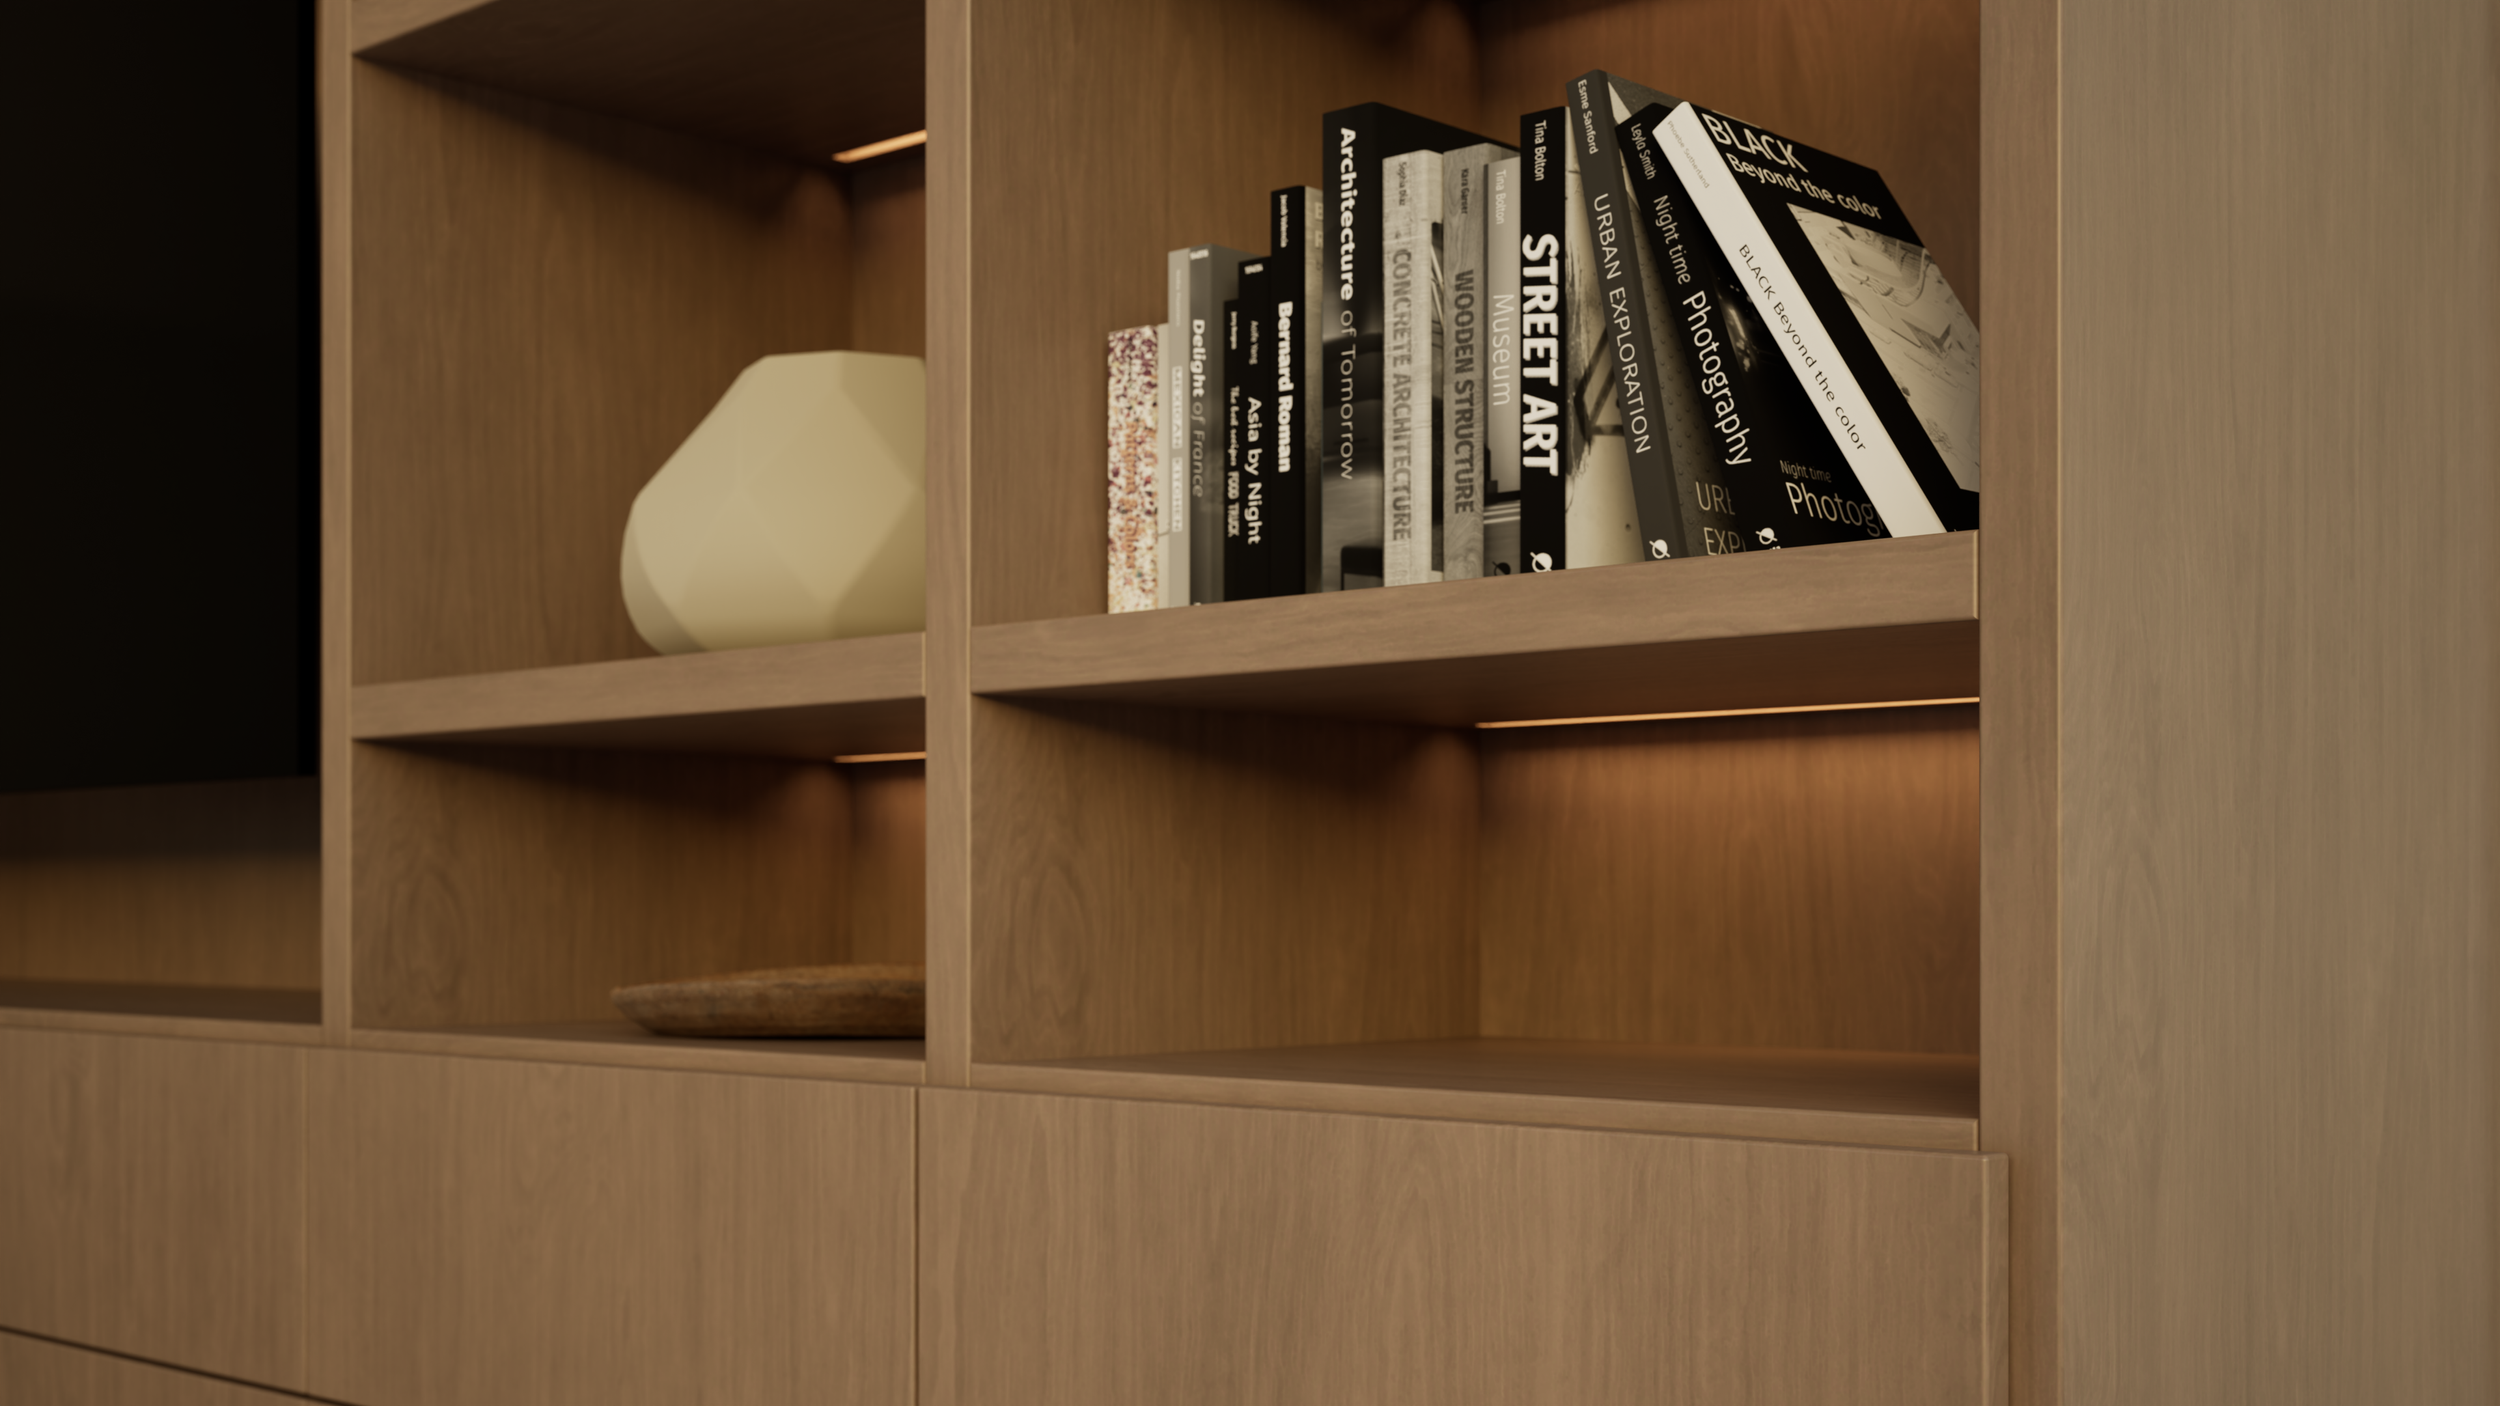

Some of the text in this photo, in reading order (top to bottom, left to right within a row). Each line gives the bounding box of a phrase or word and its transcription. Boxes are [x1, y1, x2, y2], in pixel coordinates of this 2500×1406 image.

[1534, 120, 1547, 182] Tina Bolton
[1578, 79, 1599, 155] Esme Sanford
[1631, 123, 1657, 180] Leyla Smith
[1667, 120, 1710, 189] Phoebe Sutherland
[1701, 113, 1809, 173] BLACK
[1496, 169, 1507, 225] Tina Bolton
[1725, 152, 1882, 220] Beyond the color
[1340, 127, 1358, 480] Architecture of Tomorrow
[1594, 193, 1651, 454] URBAN EXPLORATION
[1653, 195, 1752, 465] Night time Photography
[1493, 293, 1515, 406] Museum
[1522, 234, 1559, 477] STREET ART
[1738, 244, 1866, 450] BLACK Beyond the color
[1190, 319, 1207, 498] Delight of France
[1230, 385, 1240, 404] The
[1278, 301, 1294, 473] Bernard Roman
[1393, 248, 1412, 541] CONCRETE ARCHITECTURE
[1454, 269, 1475, 514] WOODEN STRUCTURE
[1171, 366, 1183, 533] MEXICAN KITCHEN
[1227, 471, 1240, 500] FOOD
[1244, 396, 1263, 545] Asia by Night
[1780, 459, 1832, 483] Night time
[1227, 502, 1240, 538] TRUCK
[1703, 526, 1747, 555] EXP
[1785, 482, 1884, 537] Photog
